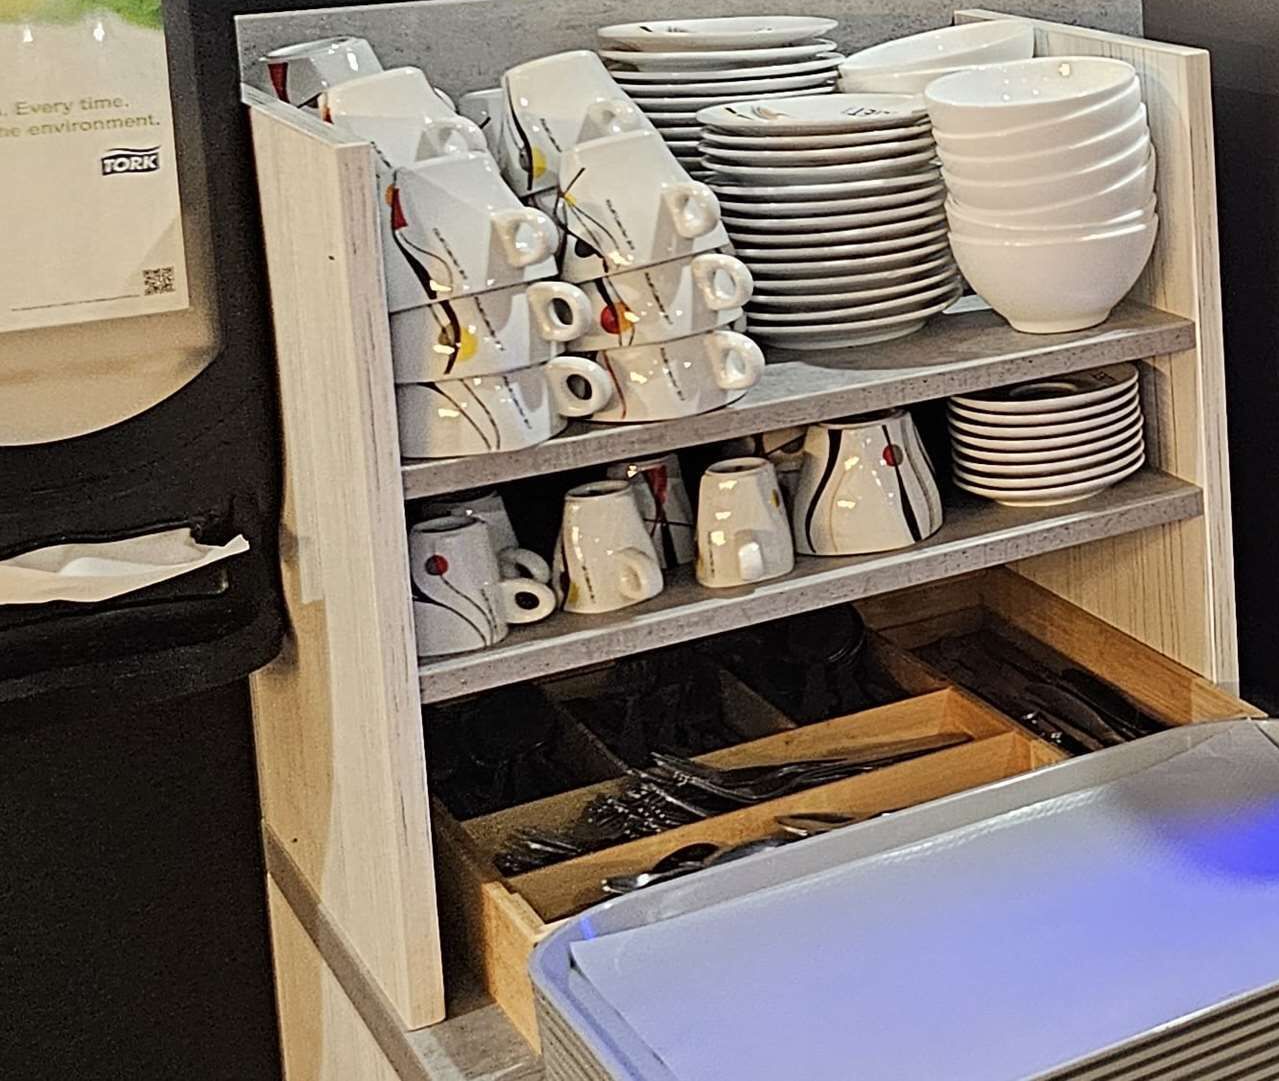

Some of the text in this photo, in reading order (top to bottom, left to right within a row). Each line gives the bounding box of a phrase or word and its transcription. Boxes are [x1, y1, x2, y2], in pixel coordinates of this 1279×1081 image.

[15, 101, 74, 116] Every
[79, 96, 130, 111] time.
[27, 114, 161, 137] environment.
[103, 155, 158, 173] TORK
